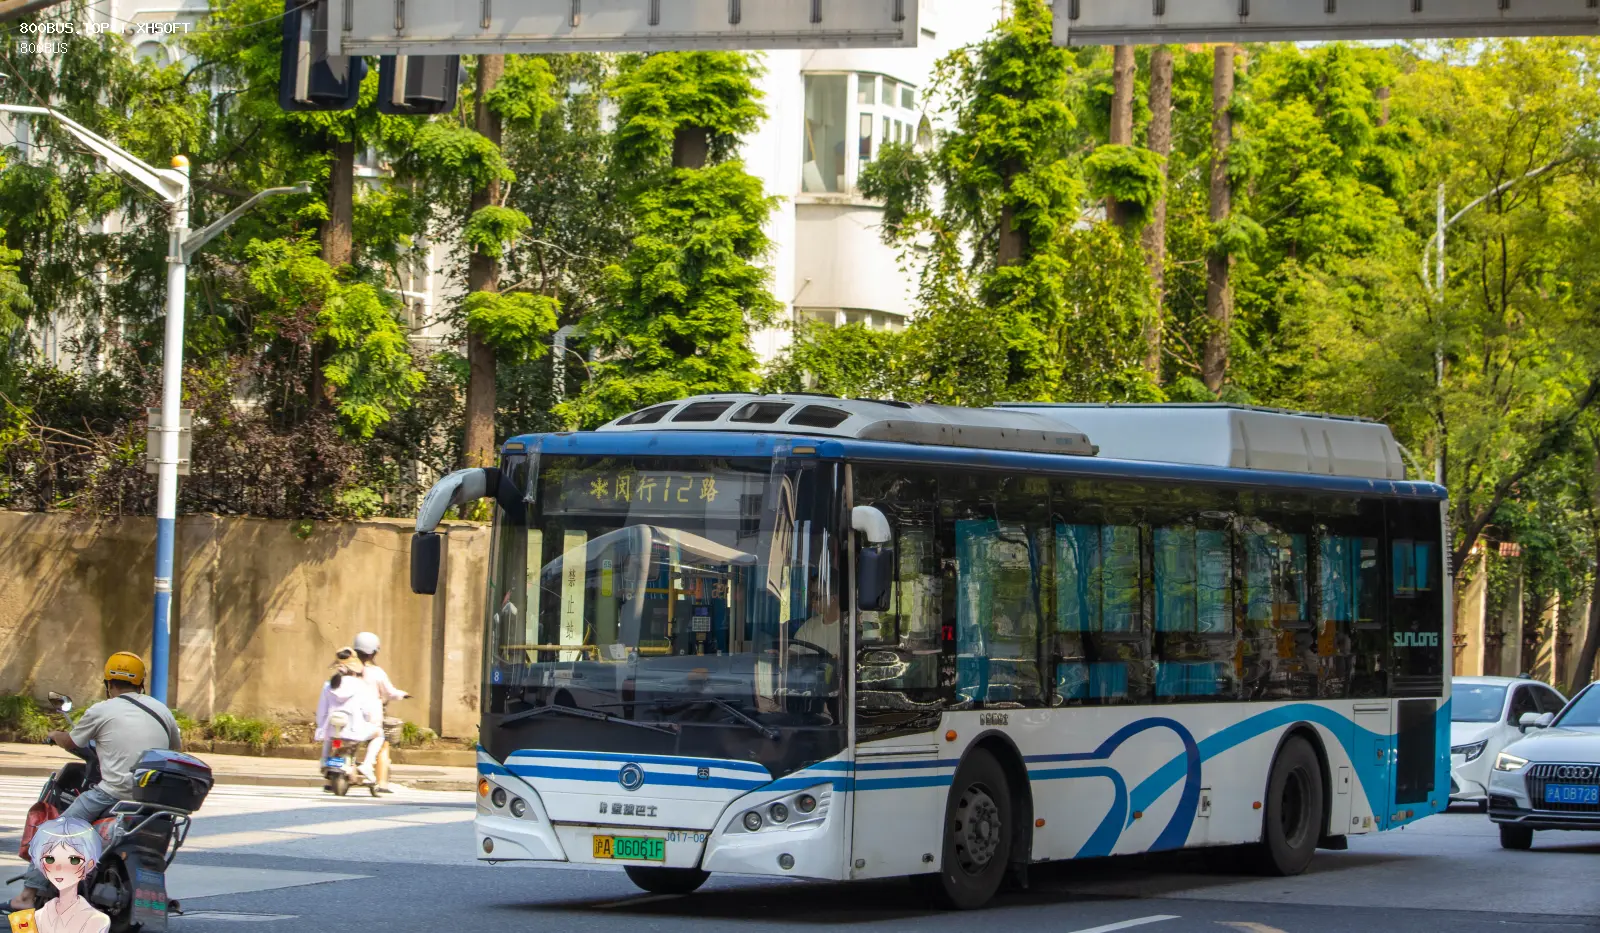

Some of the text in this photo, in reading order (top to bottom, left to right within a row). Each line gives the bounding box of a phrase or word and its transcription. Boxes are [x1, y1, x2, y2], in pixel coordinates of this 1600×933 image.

[1393, 632, 1438, 647] SUNLONG
[493, 671, 500, 682] 8
[594, 838, 611, 855] 沪A
